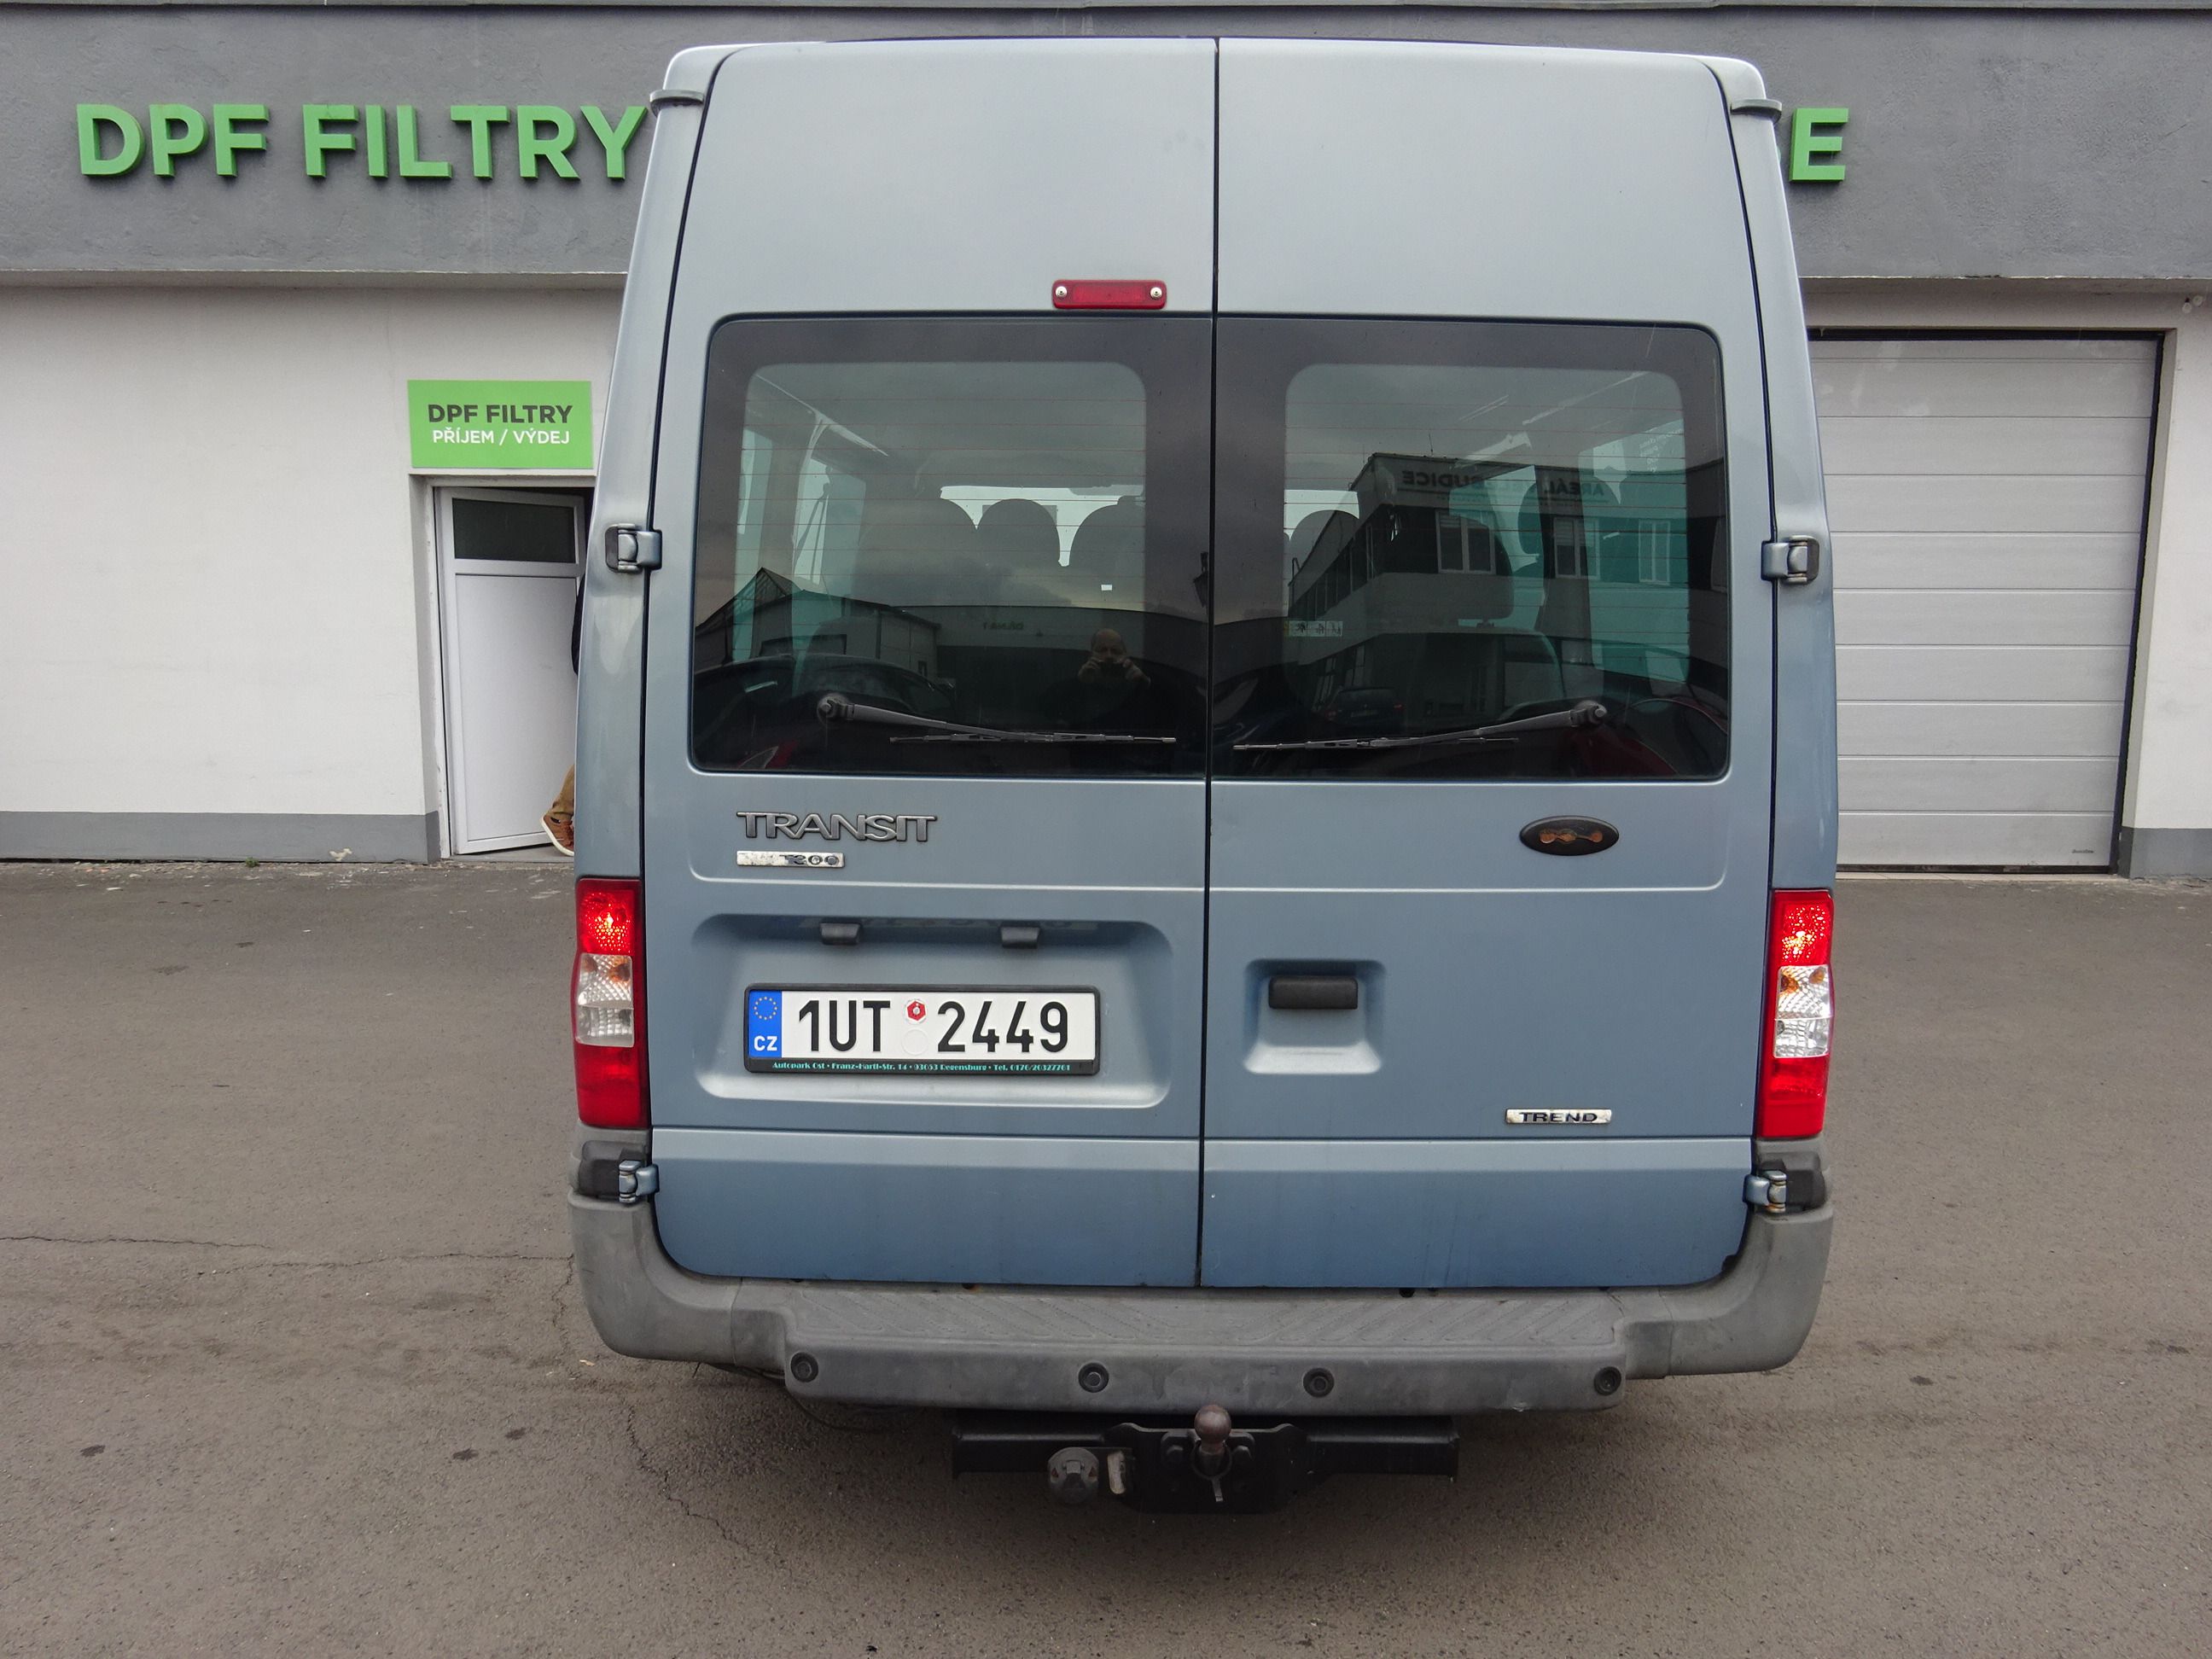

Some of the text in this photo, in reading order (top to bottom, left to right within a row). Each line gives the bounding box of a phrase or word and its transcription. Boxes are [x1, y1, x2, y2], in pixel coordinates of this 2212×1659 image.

[76, 103, 1850, 183] DPF FILTRY E
[428, 404, 573, 423] DPF FILTRY
[433, 427, 570, 445] PŘÍJEM / VÝDEJ
[736, 812, 938, 842] TRANSIT
[798, 999, 1069, 1054] 1UT 2449
[754, 1034, 778, 1052] CZ
[771, 1061, 811, 1071] Autopark
[812, 1062, 825, 1070] Ost
[992, 1063, 1009, 1072] Tel.
[1519, 1111, 1598, 1122] TREND
